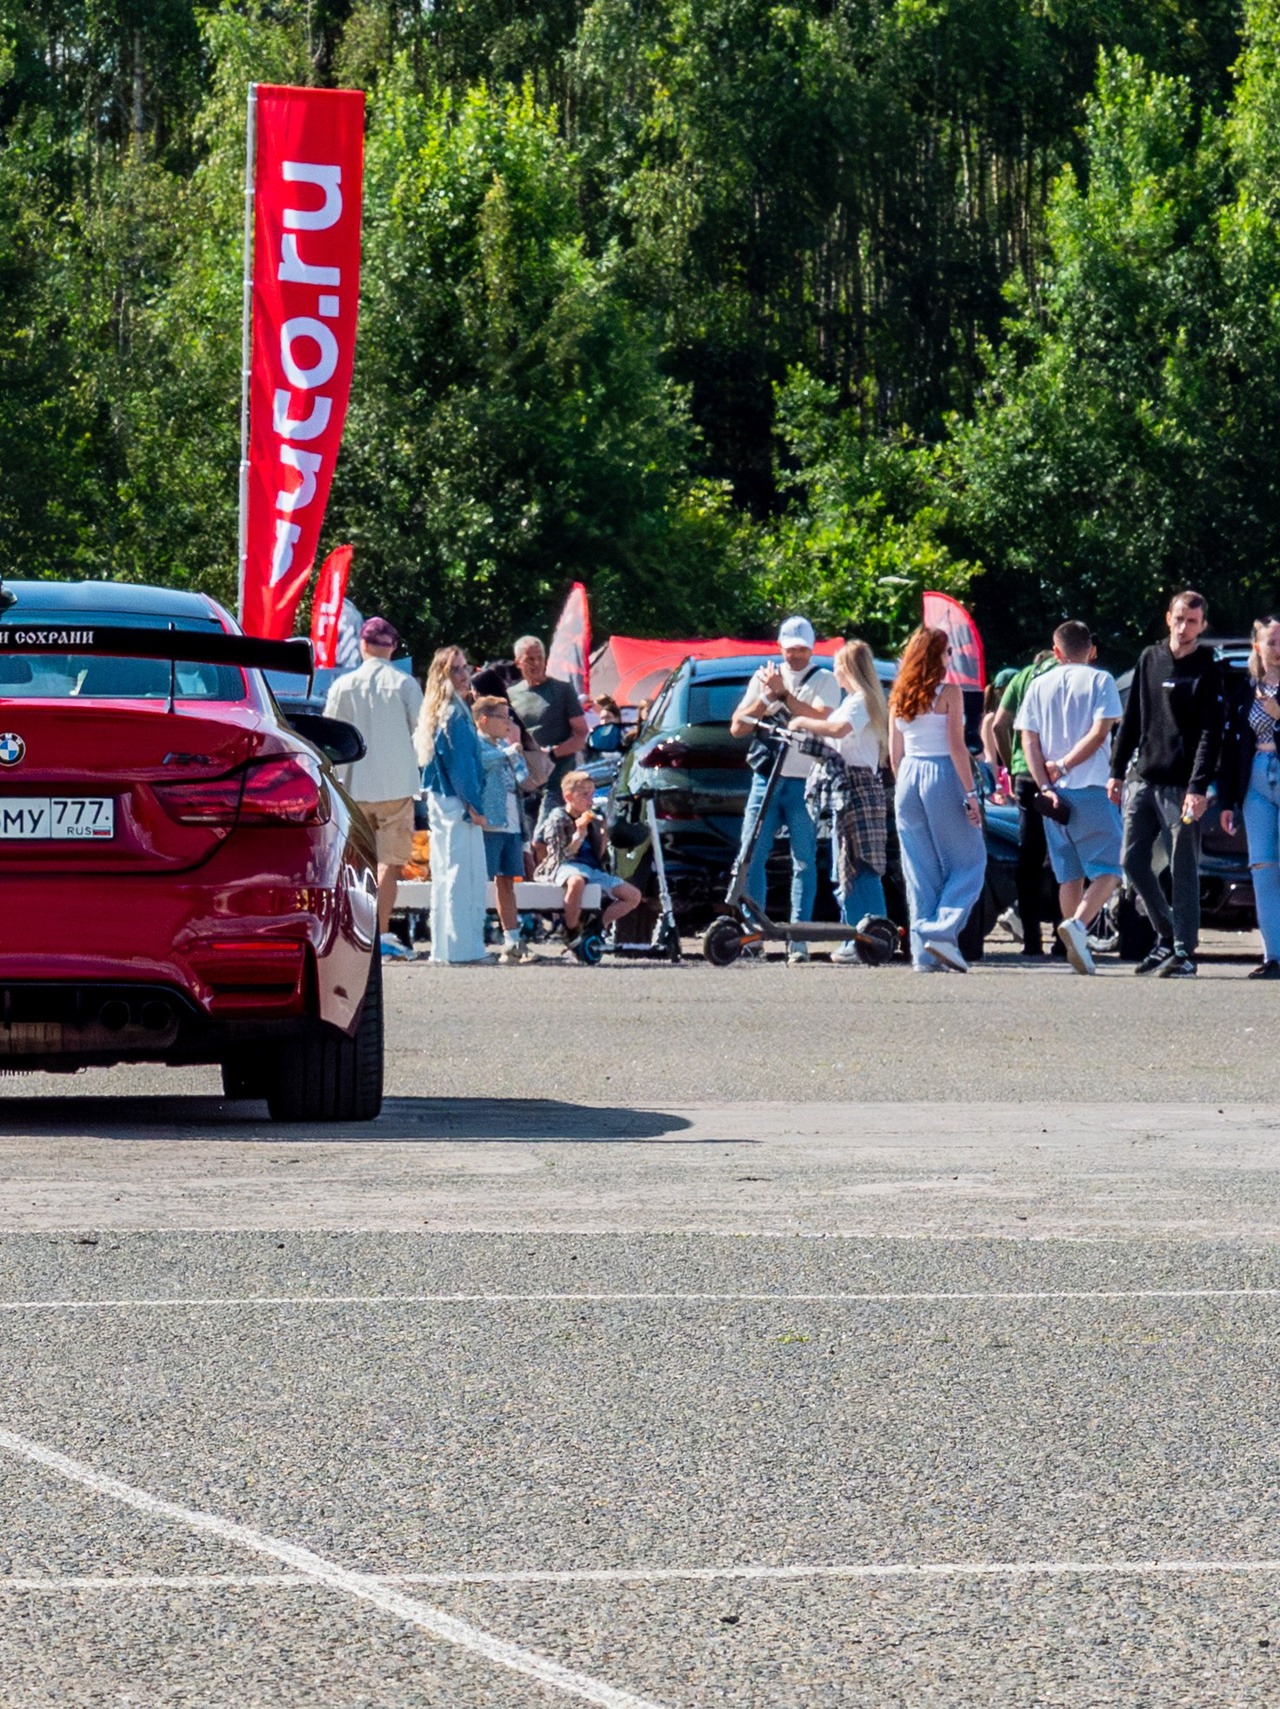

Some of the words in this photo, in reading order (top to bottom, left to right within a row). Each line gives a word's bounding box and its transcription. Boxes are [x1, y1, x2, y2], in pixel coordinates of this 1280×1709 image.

[14, 631, 95, 644] СОХРАНИ
[52, 800, 104, 825] 777
[66, 826, 92, 836] RUS
